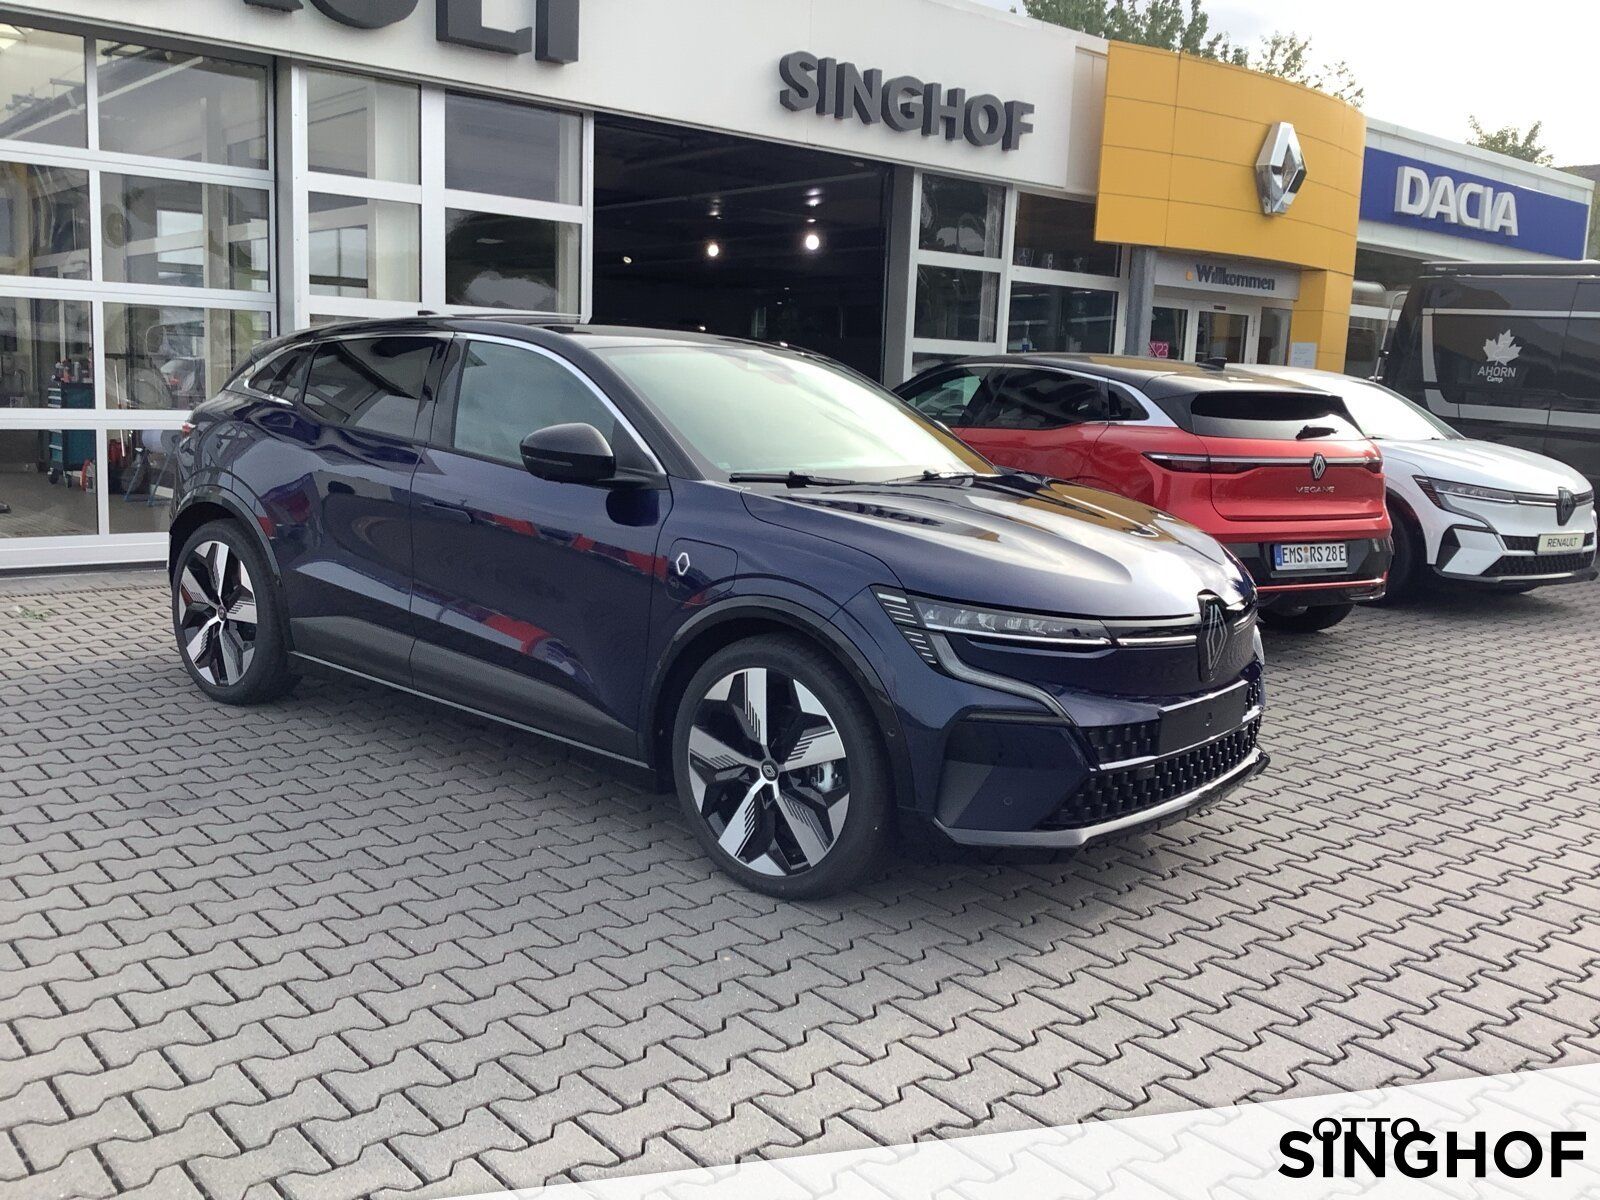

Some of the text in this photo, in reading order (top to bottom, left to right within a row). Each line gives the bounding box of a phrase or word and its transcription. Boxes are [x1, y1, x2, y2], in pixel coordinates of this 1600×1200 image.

[779, 50, 1035, 152] SINGHOF
[1394, 165, 1519, 237] DACIA
[1195, 263, 1276, 291] Willkommen
[1477, 366, 1517, 378] AHORN
[1486, 375, 1504, 384] Camp
[1546, 536, 1579, 548] RENAULT
[1282, 547, 1303, 564] EMS
[1309, 546, 1323, 563] RS
